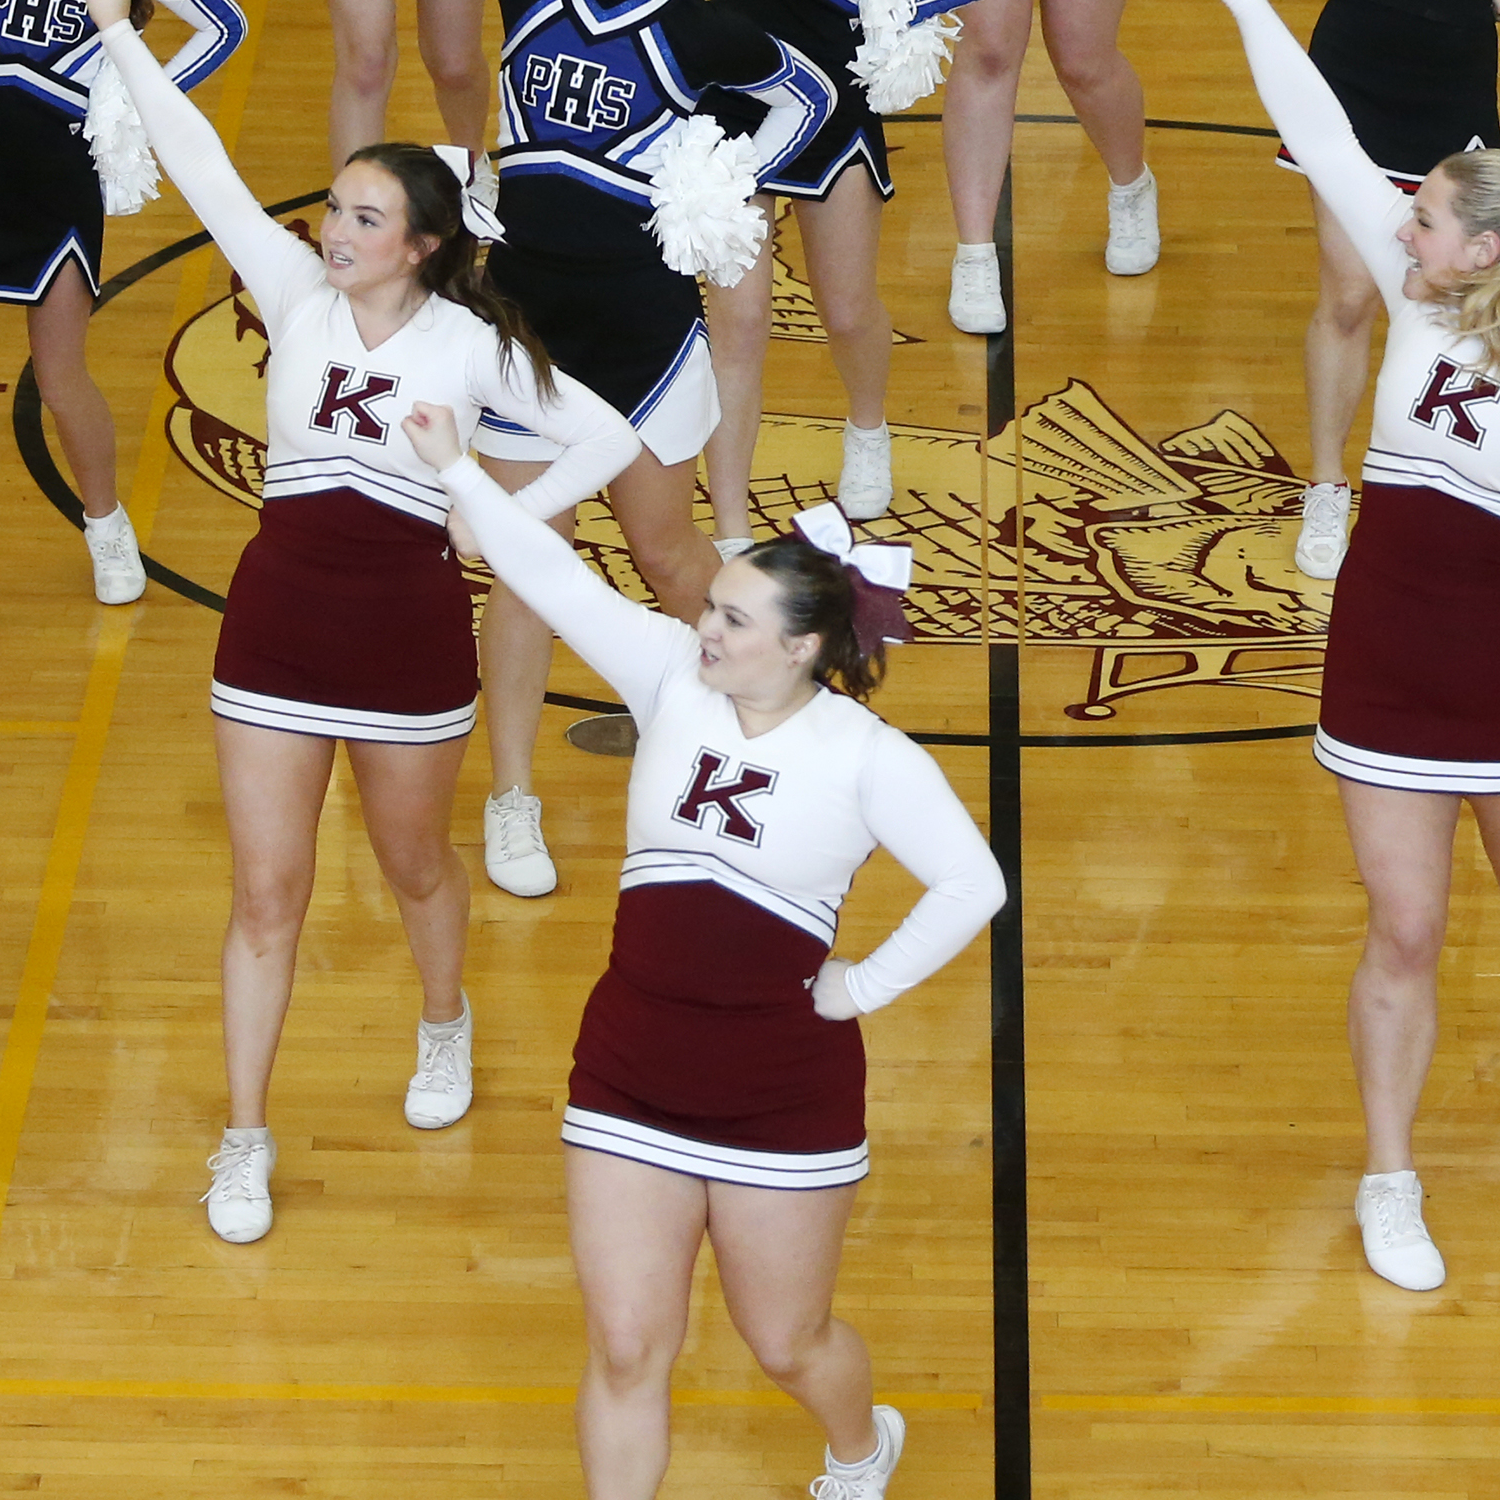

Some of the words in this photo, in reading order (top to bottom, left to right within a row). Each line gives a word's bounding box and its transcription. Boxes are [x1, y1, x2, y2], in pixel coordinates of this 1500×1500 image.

[522, 51, 637, 133] PHS
[309, 359, 402, 446] K
[671, 745, 779, 849] K
